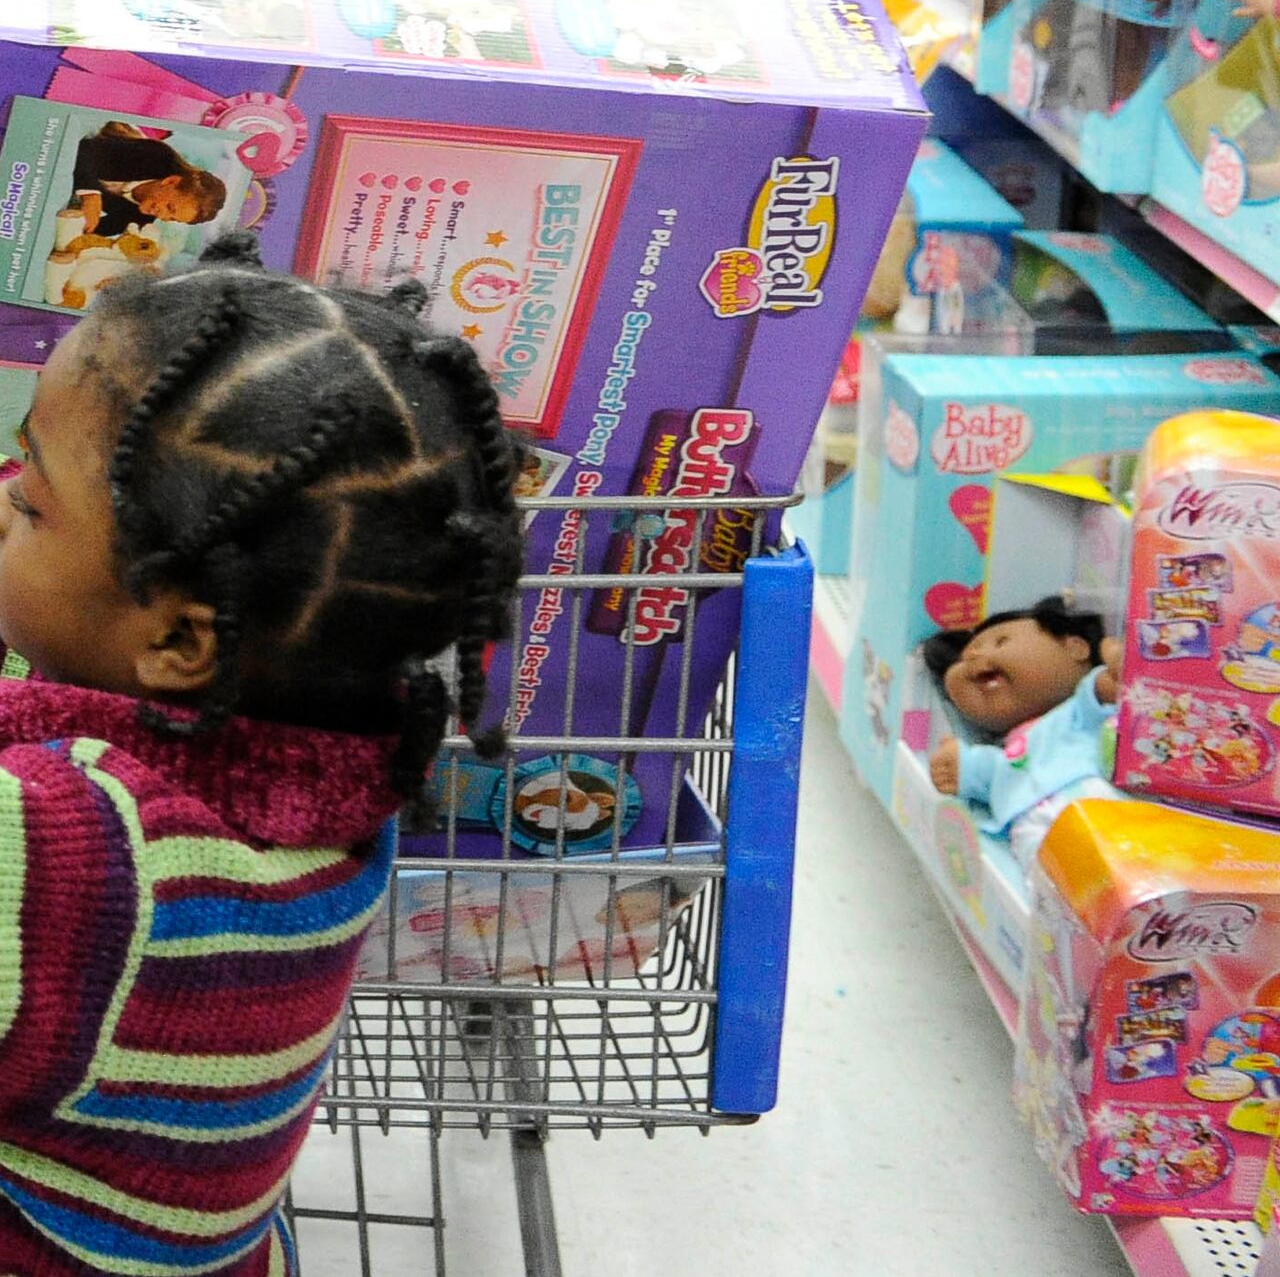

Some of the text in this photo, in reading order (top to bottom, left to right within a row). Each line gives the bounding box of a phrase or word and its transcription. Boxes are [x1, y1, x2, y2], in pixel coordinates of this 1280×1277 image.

[9, 161, 29, 184] So
[3, 116, 60, 293] She turns whinnies when pet her!
[639, 229, 673, 277] Place
[763, 158, 839, 309] FurReal
[496, 183, 582, 401] BEST IN SHOW
[629, 279, 658, 308] for
[716, 253, 752, 315] friends
[596, 311, 652, 411] Smartest
[580, 414, 619, 468] Pony,
[658, 433, 677, 455] My
[945, 402, 1026, 449] Baby
[940, 437, 1009, 475] Alive
[620, 408, 755, 646] Buttrsctch
[529, 562, 571, 632] Nzzles
[519, 644, 549, 687] Best
